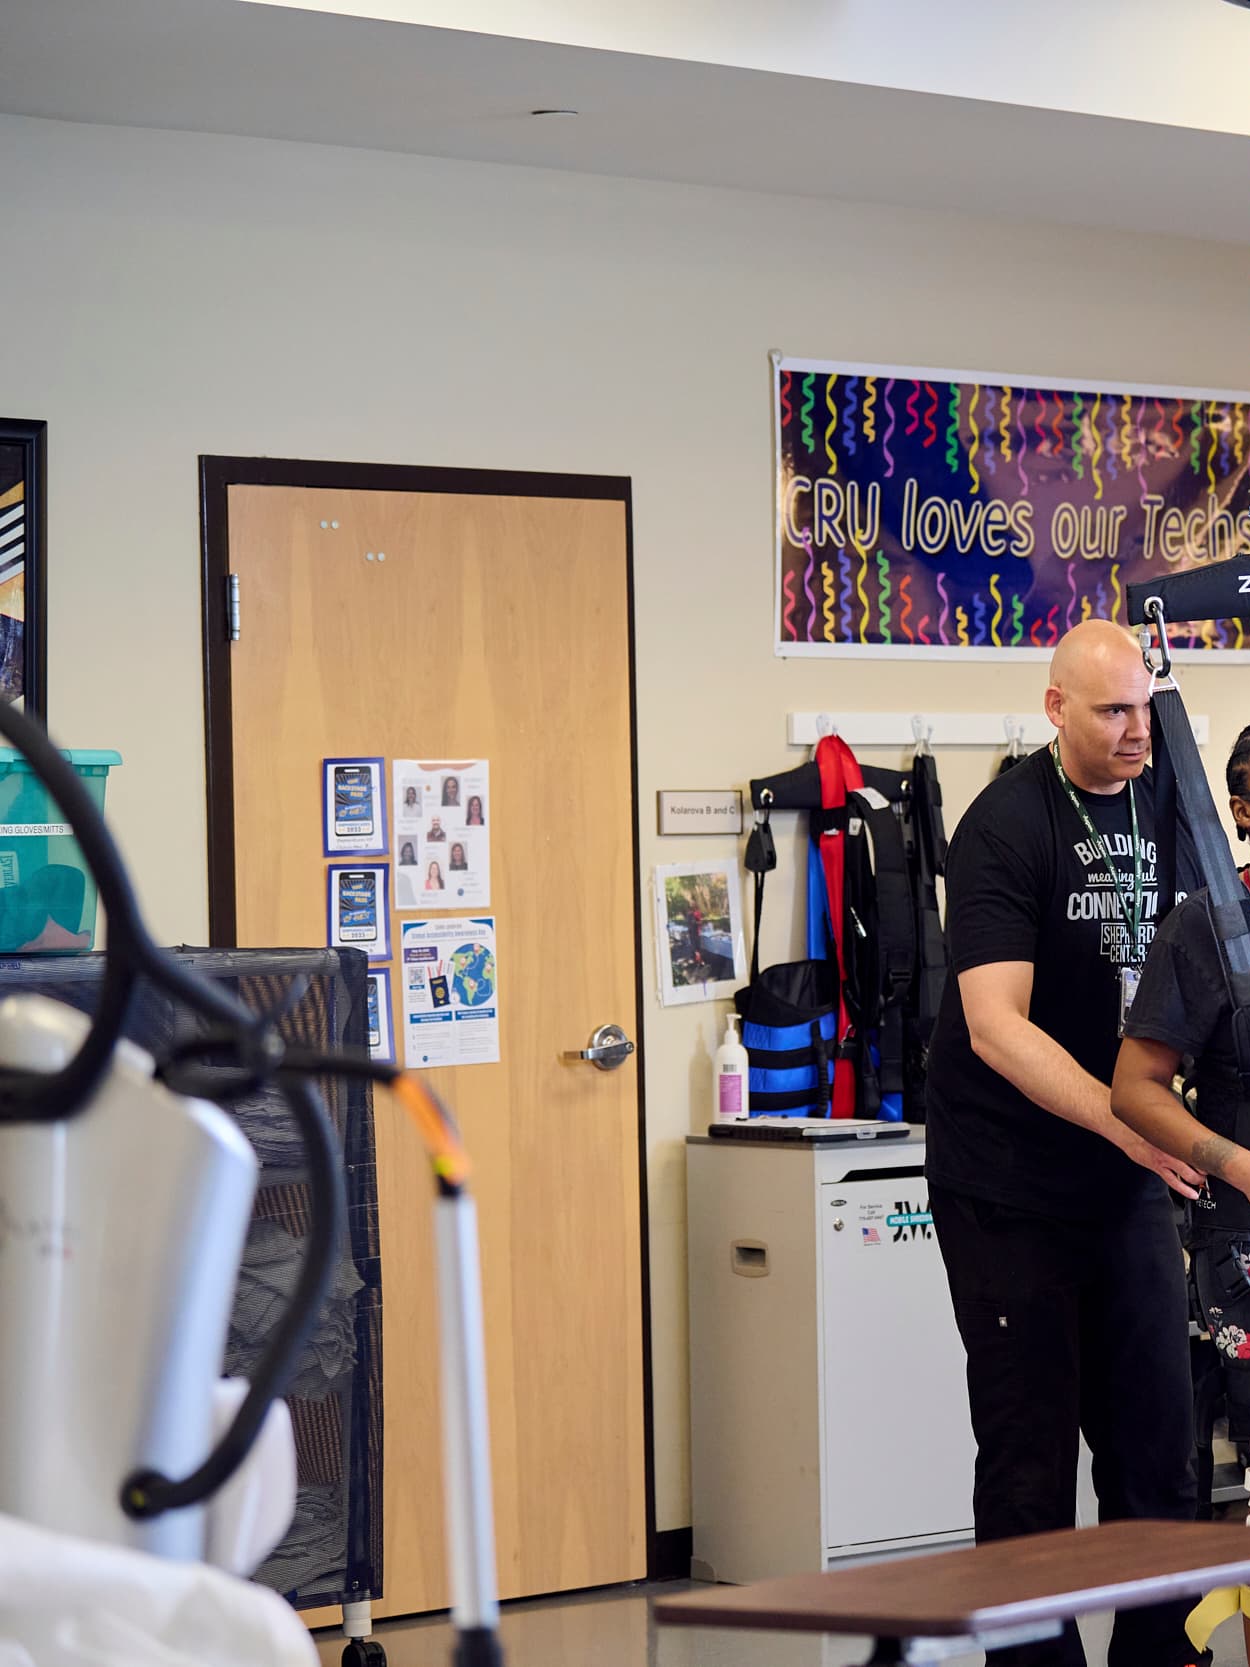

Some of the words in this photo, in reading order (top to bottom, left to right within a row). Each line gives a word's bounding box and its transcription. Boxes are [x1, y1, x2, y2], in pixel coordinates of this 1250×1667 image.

[782, 476, 881, 550] CRU
[902, 478, 1035, 558] loves
[1052, 503, 1127, 560] our
[671, 806, 704, 815] Kolarova
[706, 806, 712, 815] B
[713, 806, 728, 815] and
[729, 806, 736, 815] C
[1073, 833, 1157, 866] BULDING
[1087, 864, 1158, 890] meaingul
[1103, 925, 1155, 944] SHEPHRD
